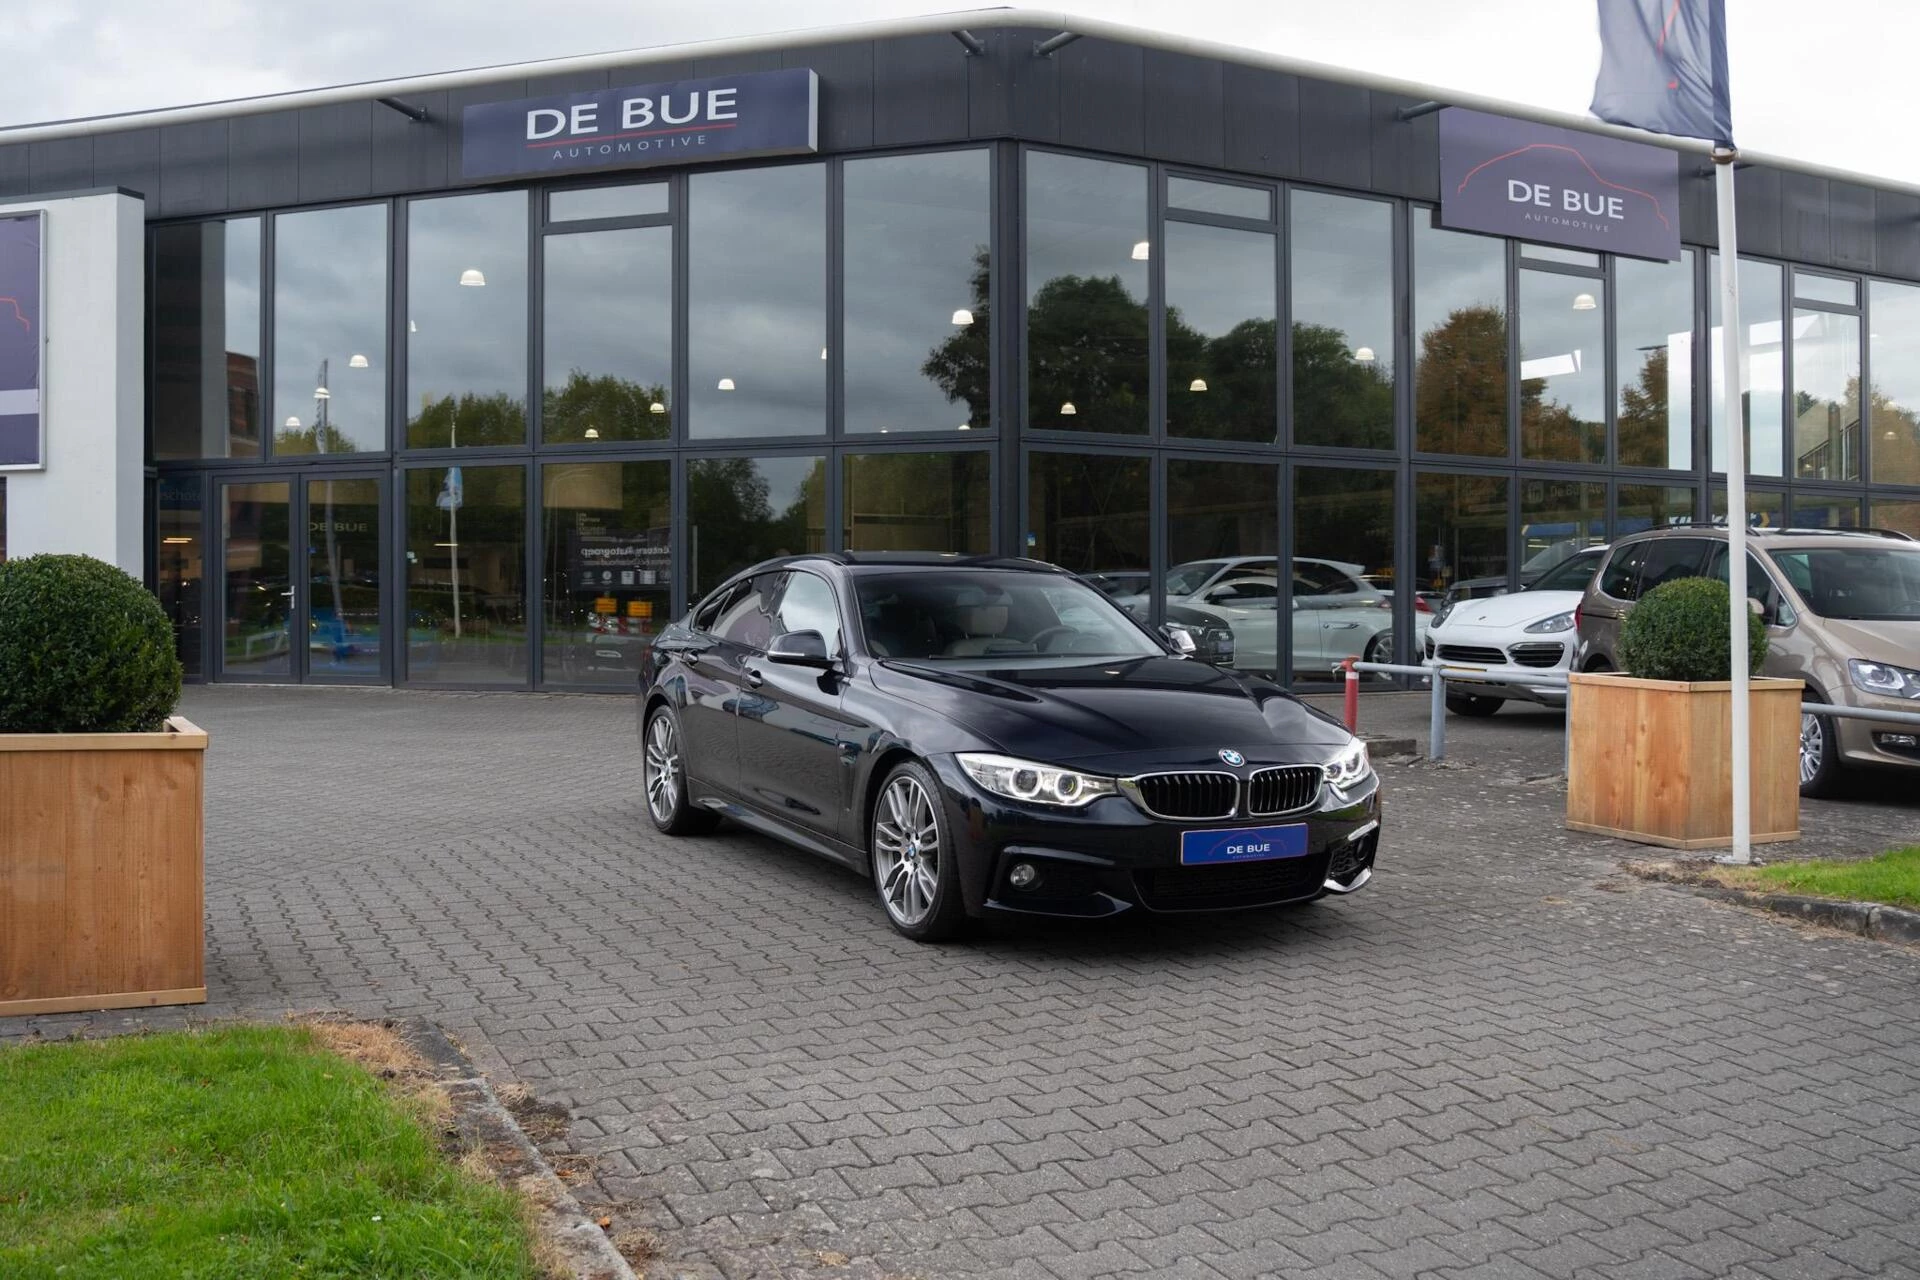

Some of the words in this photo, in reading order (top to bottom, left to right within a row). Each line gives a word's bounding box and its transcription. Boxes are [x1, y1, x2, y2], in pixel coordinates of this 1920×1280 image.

[527, 102, 598, 140] DE
[622, 88, 738, 129] BUE
[553, 135, 706, 160] AUTOMOTIVE
[1508, 179, 1551, 207] DE
[1563, 189, 1624, 219] BUE
[1525, 213, 1609, 232] AUTOMOTIVE
[309, 521, 328, 531] DE
[334, 521, 369, 532] BUE
[1227, 846, 1243, 854] DE
[1247, 844, 1270, 853] BUE
